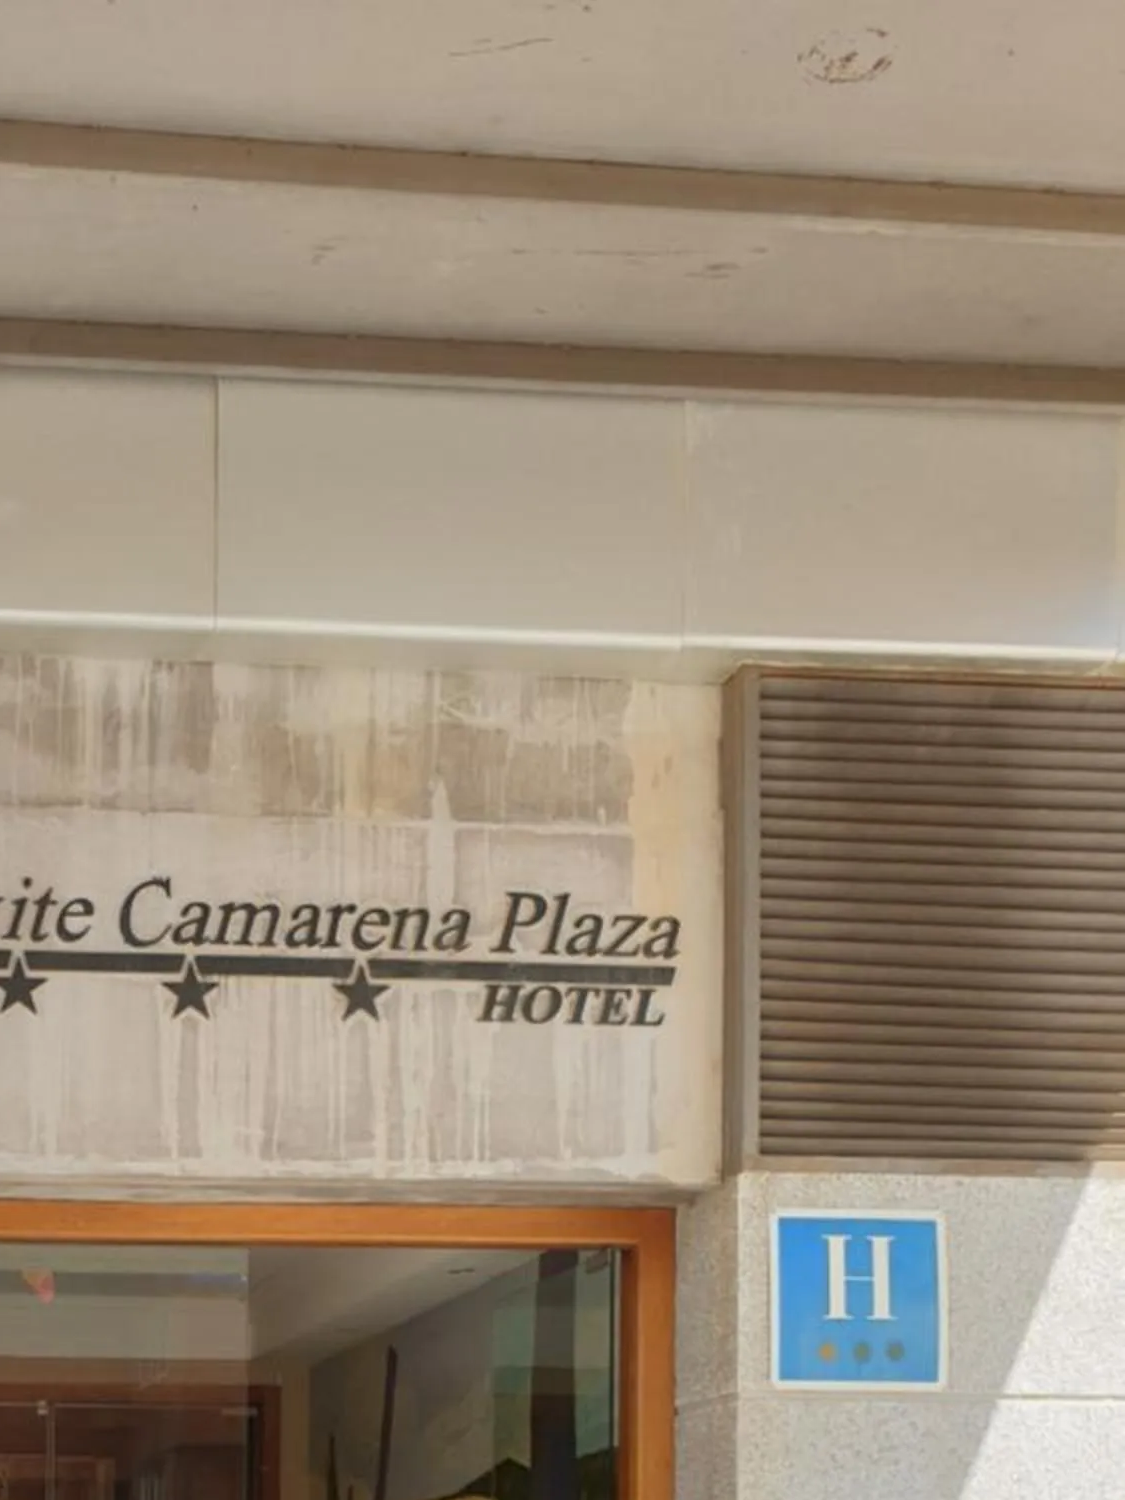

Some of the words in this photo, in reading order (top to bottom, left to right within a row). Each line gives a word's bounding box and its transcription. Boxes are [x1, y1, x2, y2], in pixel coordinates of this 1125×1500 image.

[119, 877, 472, 953] Camarena
[489, 891, 682, 960] Plaza
[478, 983, 666, 1028] HOTEL
[821, 1234, 899, 1321] H
